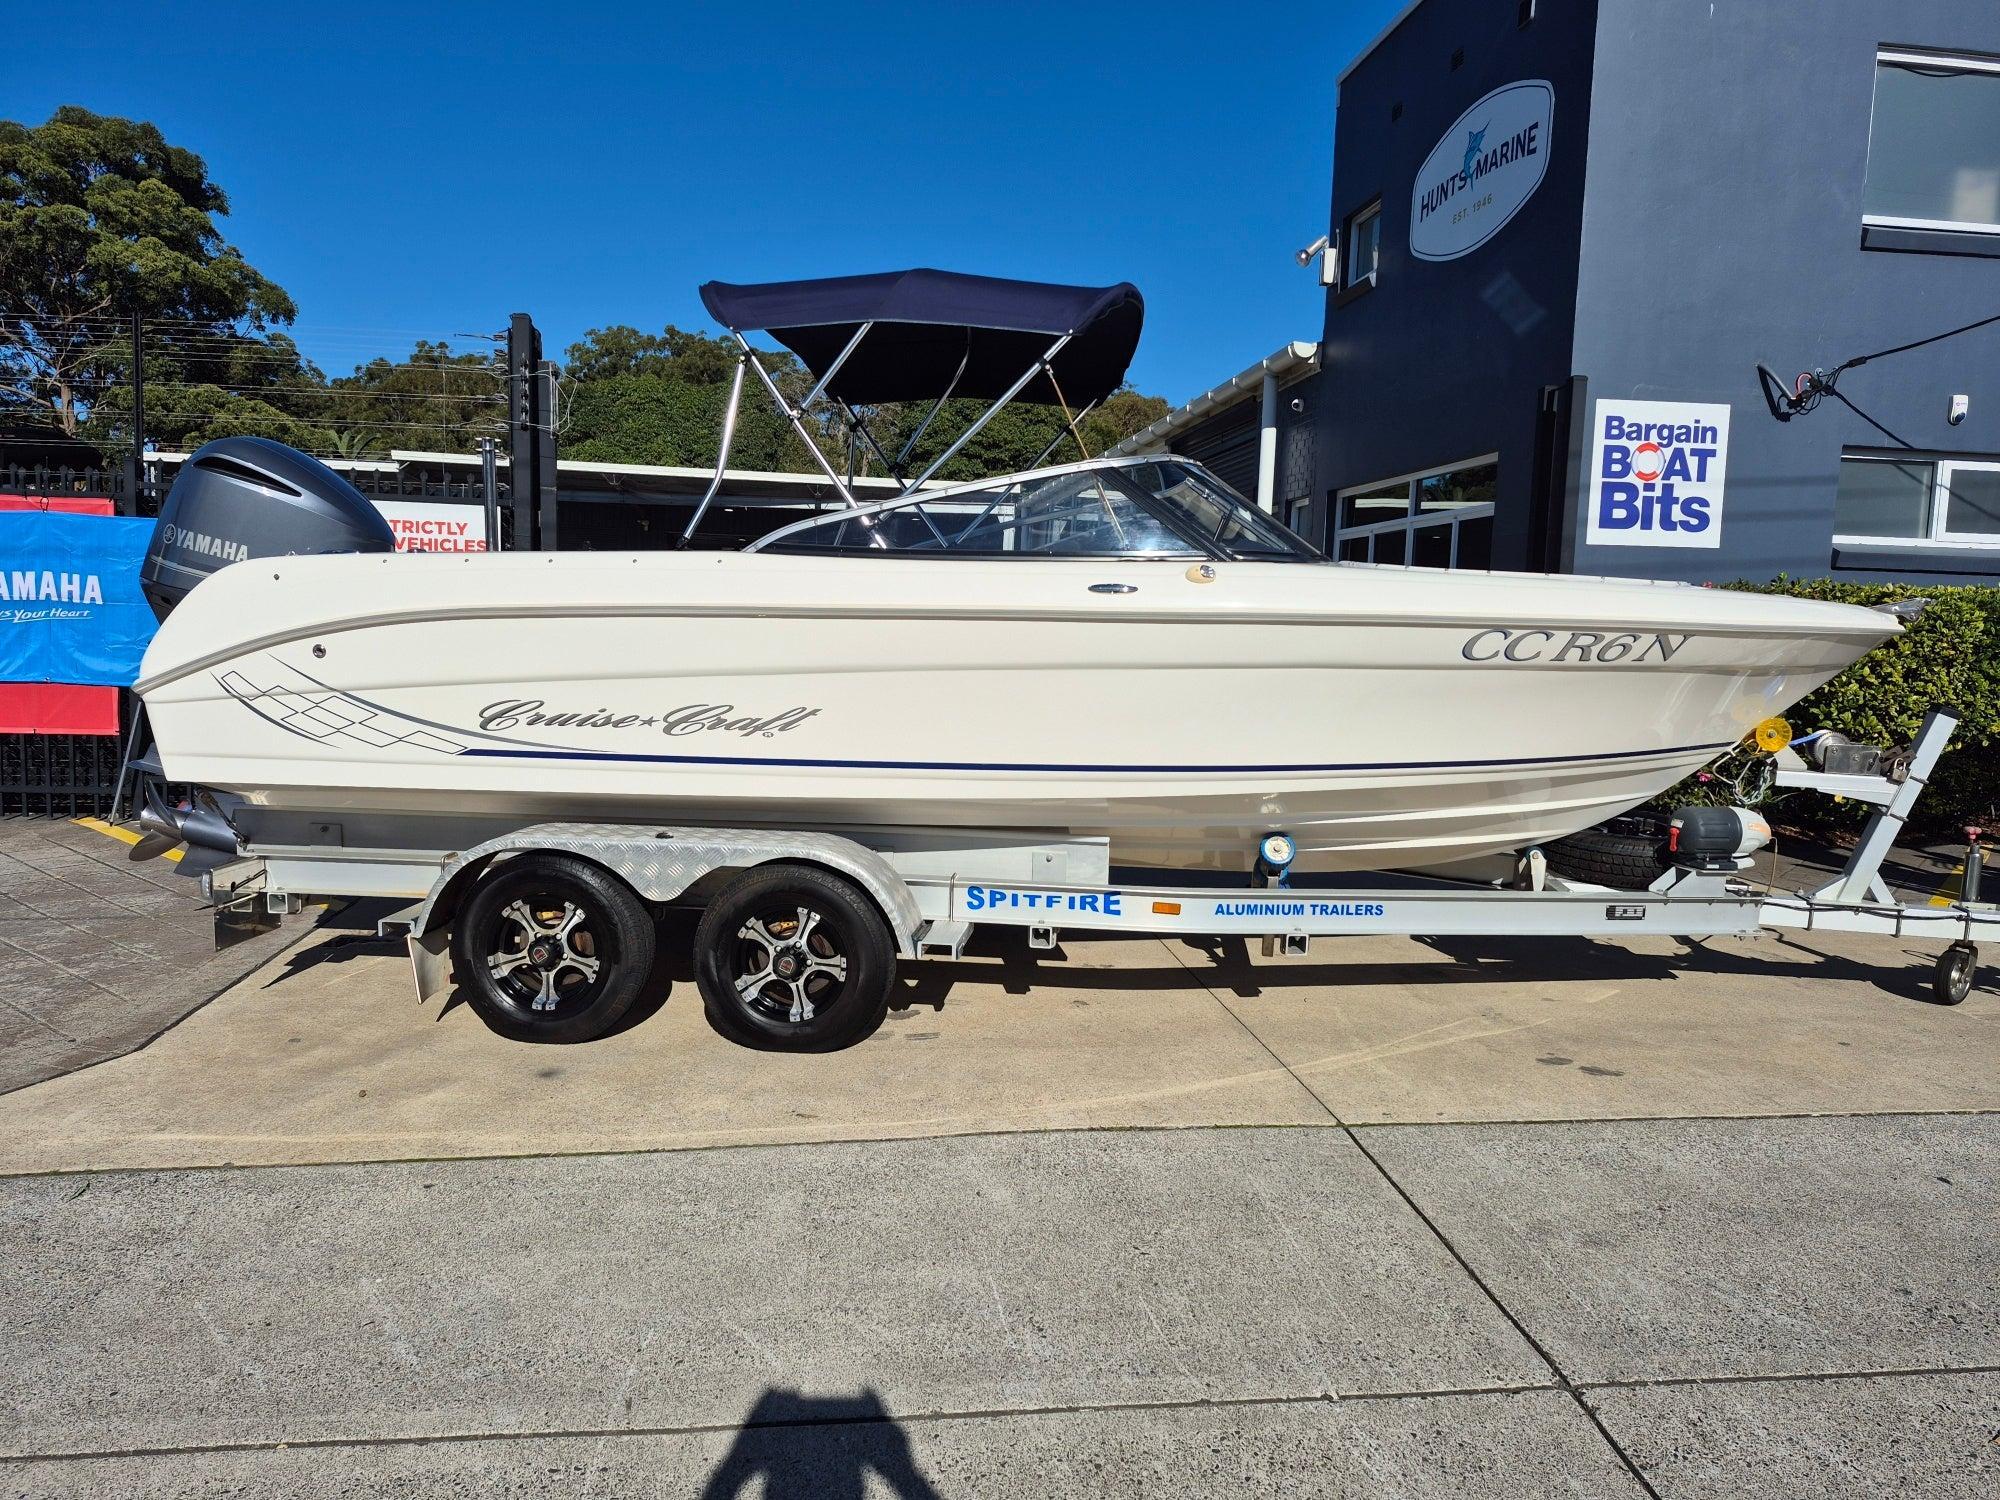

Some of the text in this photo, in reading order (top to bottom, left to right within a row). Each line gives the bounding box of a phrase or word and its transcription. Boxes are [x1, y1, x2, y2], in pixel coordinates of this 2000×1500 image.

[1420, 121, 1539, 222] HUNTS MARINE
[1452, 193, 1493, 225] EST. 1946
[1604, 415, 1718, 448] Bargain
[1602, 442, 1717, 482] BOAT
[1598, 481, 1711, 533] Bits
[388, 519, 468, 535] TRICTLY
[176, 528, 249, 561] YAMAHA
[49, 608, 91, 617] Heart
[479, 699, 823, 737] Cruise Craft
[966, 885, 1122, 916] SPITFIRE
[1214, 903, 1384, 916] ALUMINIUM TRAILERS
